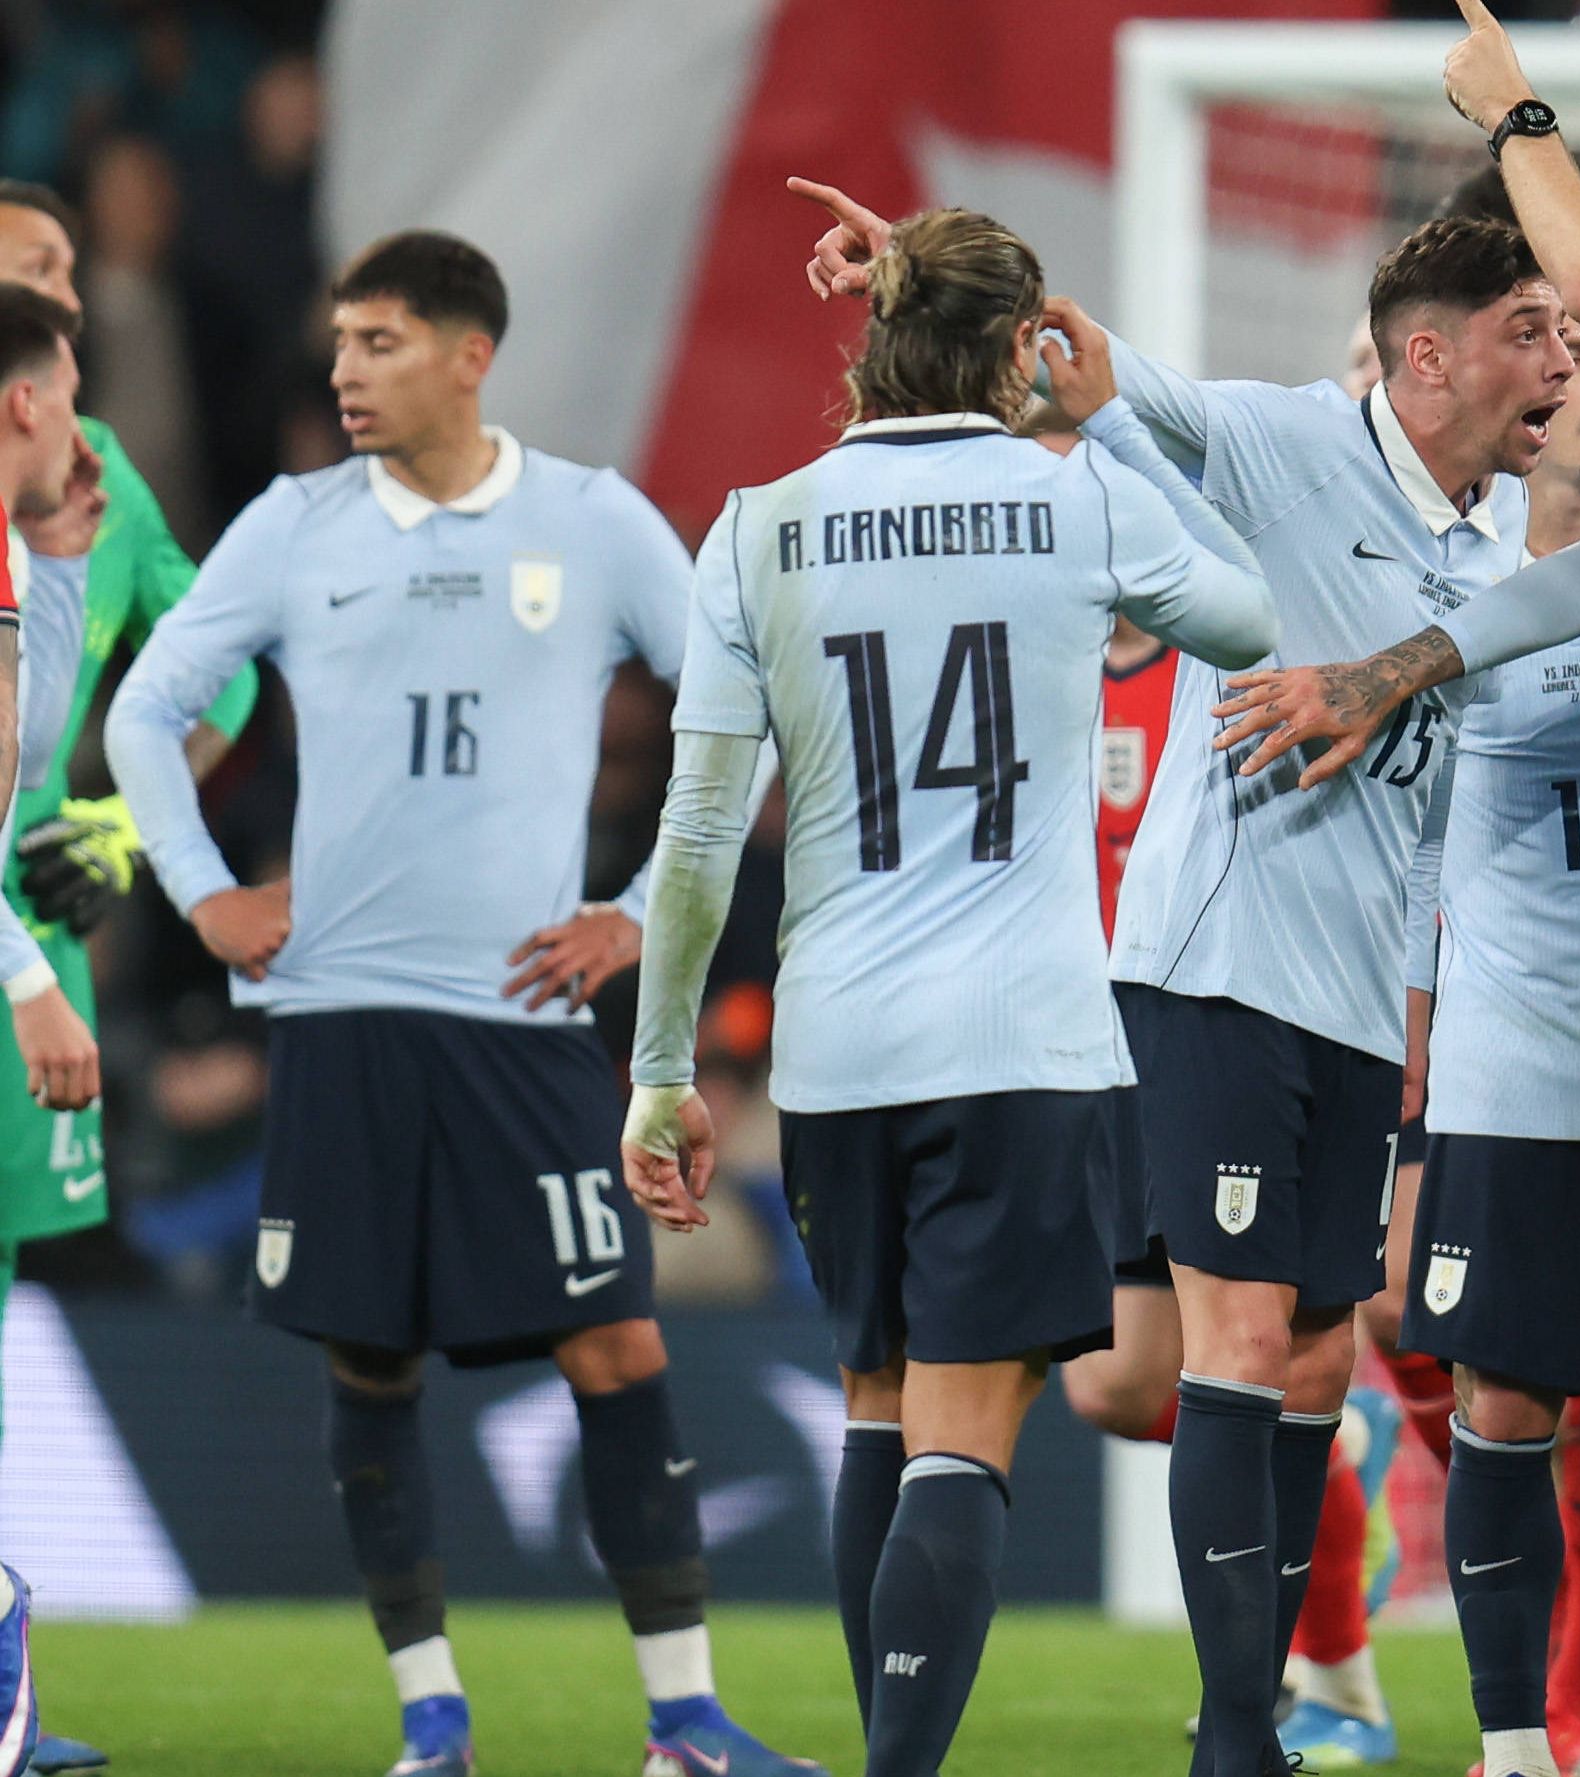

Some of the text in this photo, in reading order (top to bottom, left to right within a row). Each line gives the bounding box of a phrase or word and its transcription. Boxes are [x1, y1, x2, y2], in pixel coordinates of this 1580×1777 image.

[406, 690, 480, 776] 16
[823, 621, 1030, 872] 14
[1367, 696, 1448, 789] 15
[536, 1167, 624, 1265] 16
[883, 1651, 927, 1678] AUF
